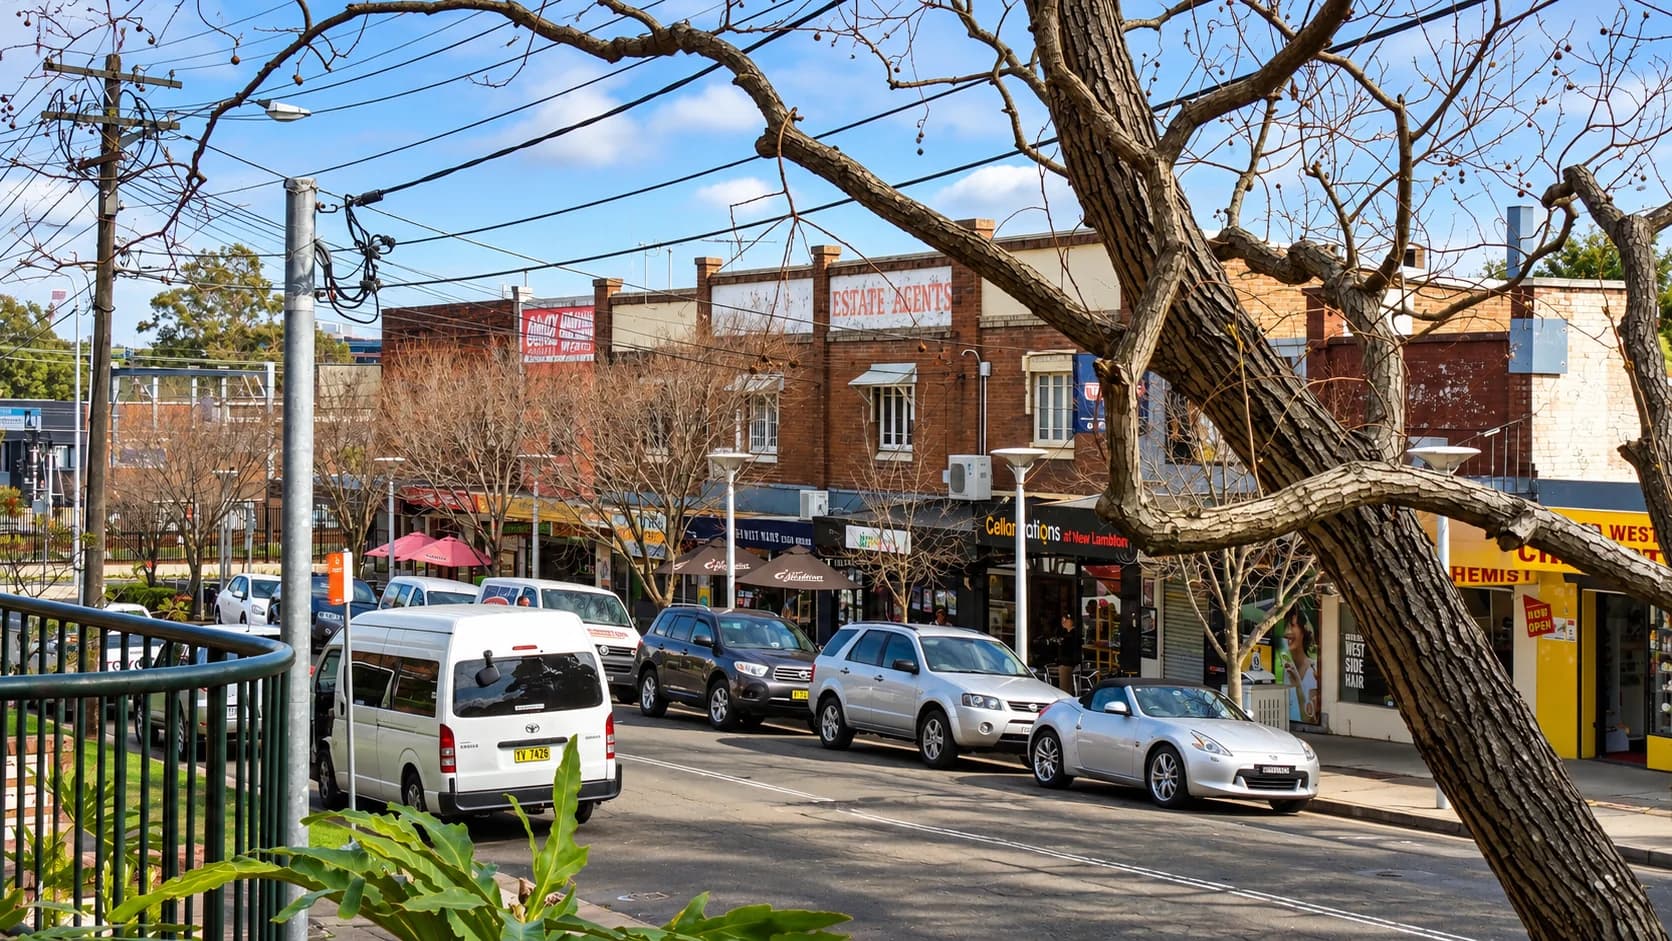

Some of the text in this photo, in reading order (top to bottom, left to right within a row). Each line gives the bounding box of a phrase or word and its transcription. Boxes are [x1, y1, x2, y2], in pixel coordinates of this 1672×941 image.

[832, 282, 951, 318] ESTATE AGENTS
[1073, 531, 1090, 544] New
[1091, 531, 1128, 548] Lambton
[1451, 566, 1530, 583] HEMIST
[1528, 608, 1548, 619] NOW
[1529, 620, 1551, 632] OPEN
[1345, 641, 1365, 658] WEST
[1345, 658, 1364, 673] SIDE
[1345, 673, 1364, 688] HAIR
